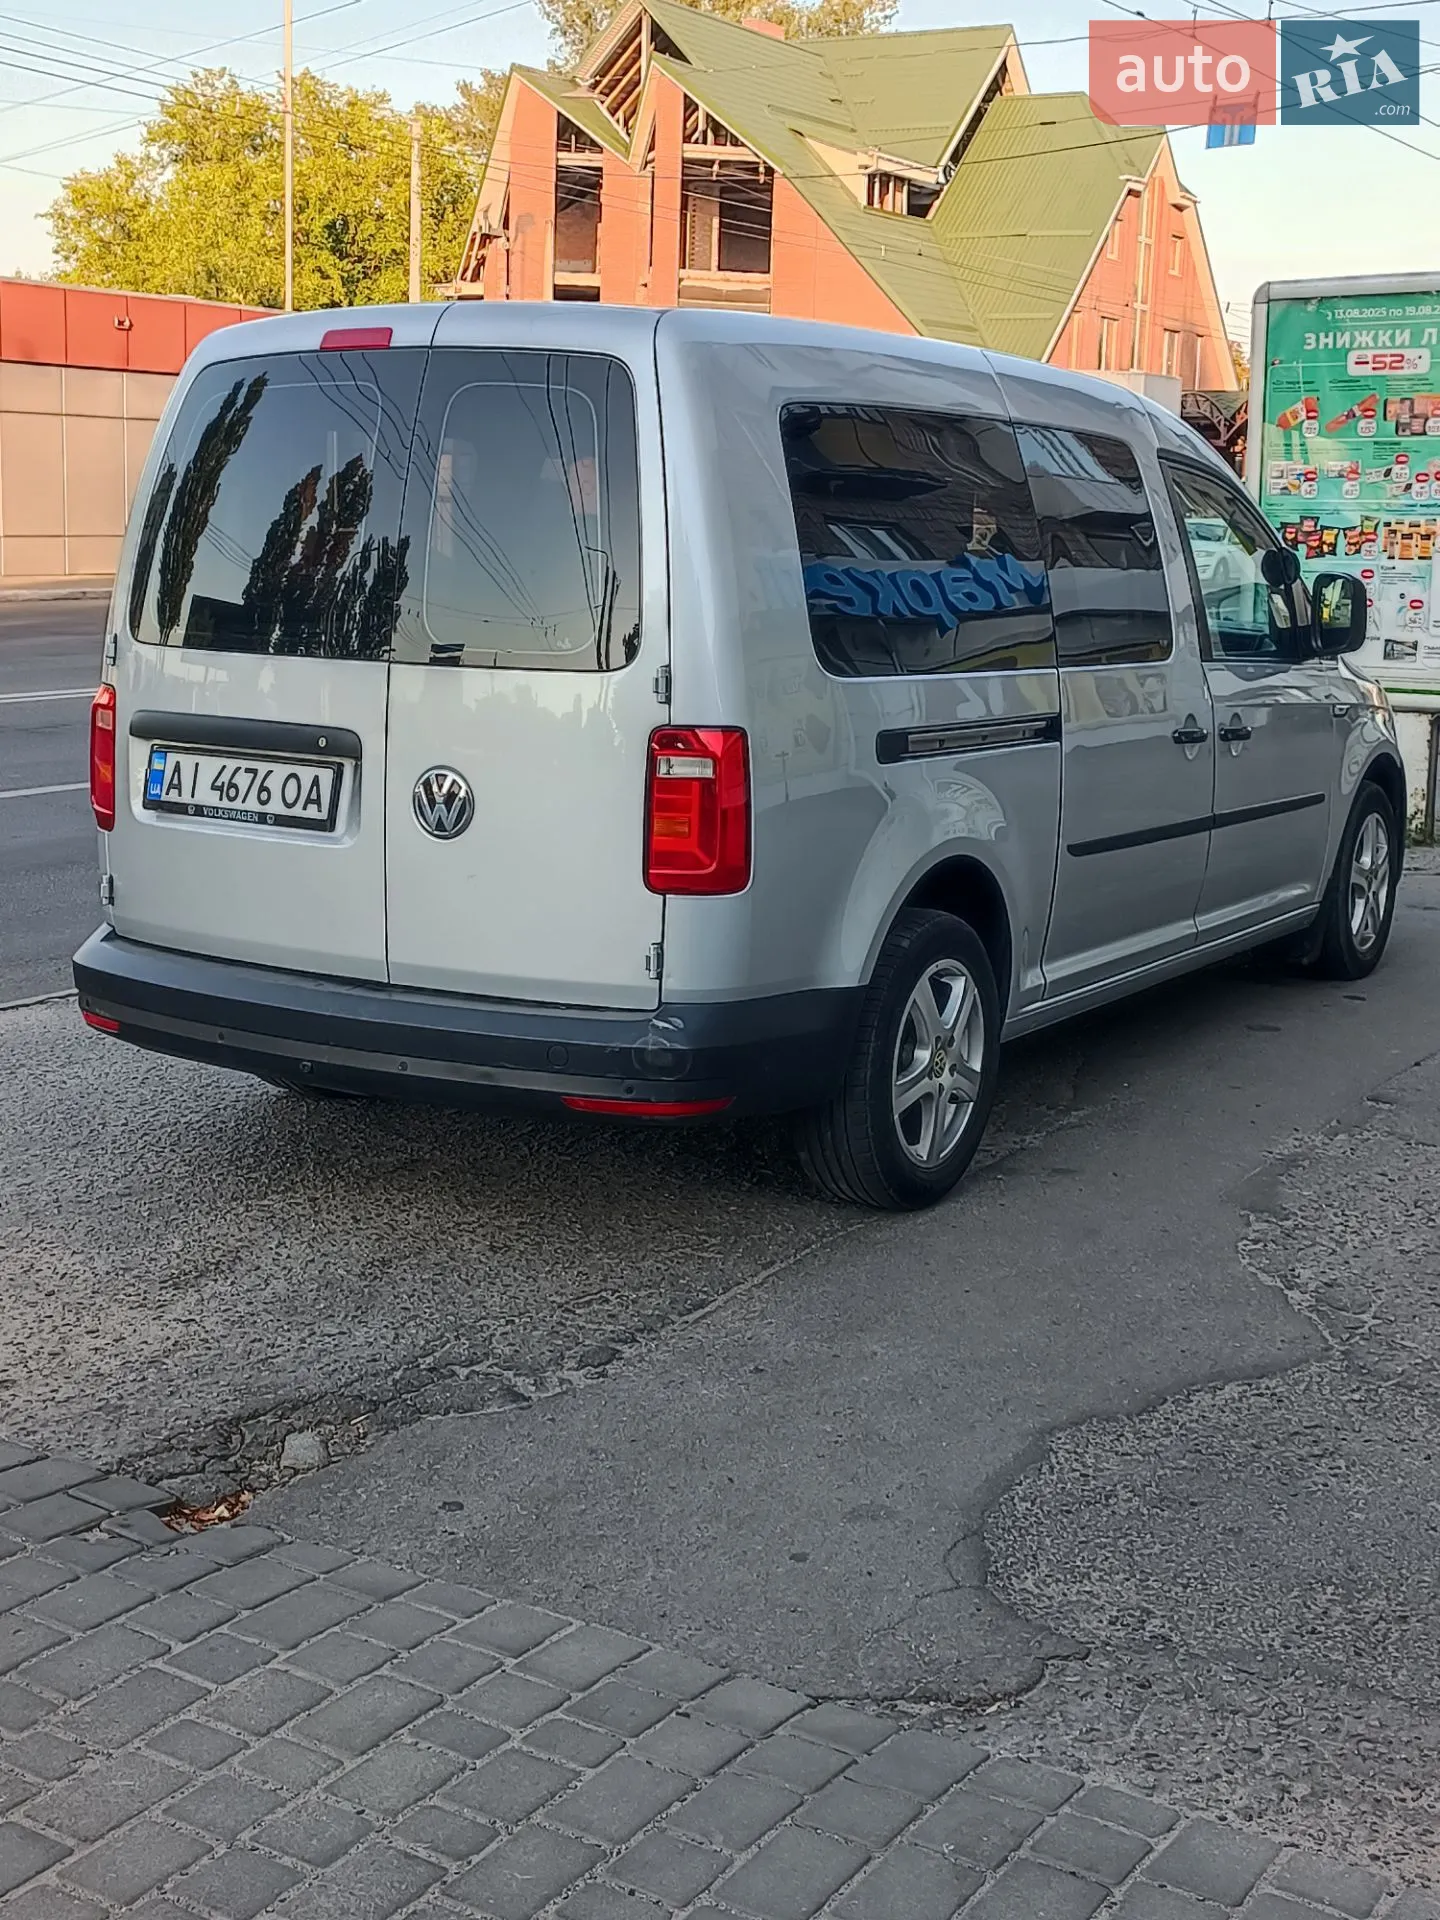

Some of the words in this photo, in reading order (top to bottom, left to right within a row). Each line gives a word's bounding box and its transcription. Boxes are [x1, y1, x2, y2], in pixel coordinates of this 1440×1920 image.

[1334, 307, 1387, 319] 13.08.2025
[1303, 328, 1411, 350] ЗНИЖКИ
[210, 764, 275, 806] 4676
[202, 806, 259, 822] VOLKSWAGEN
